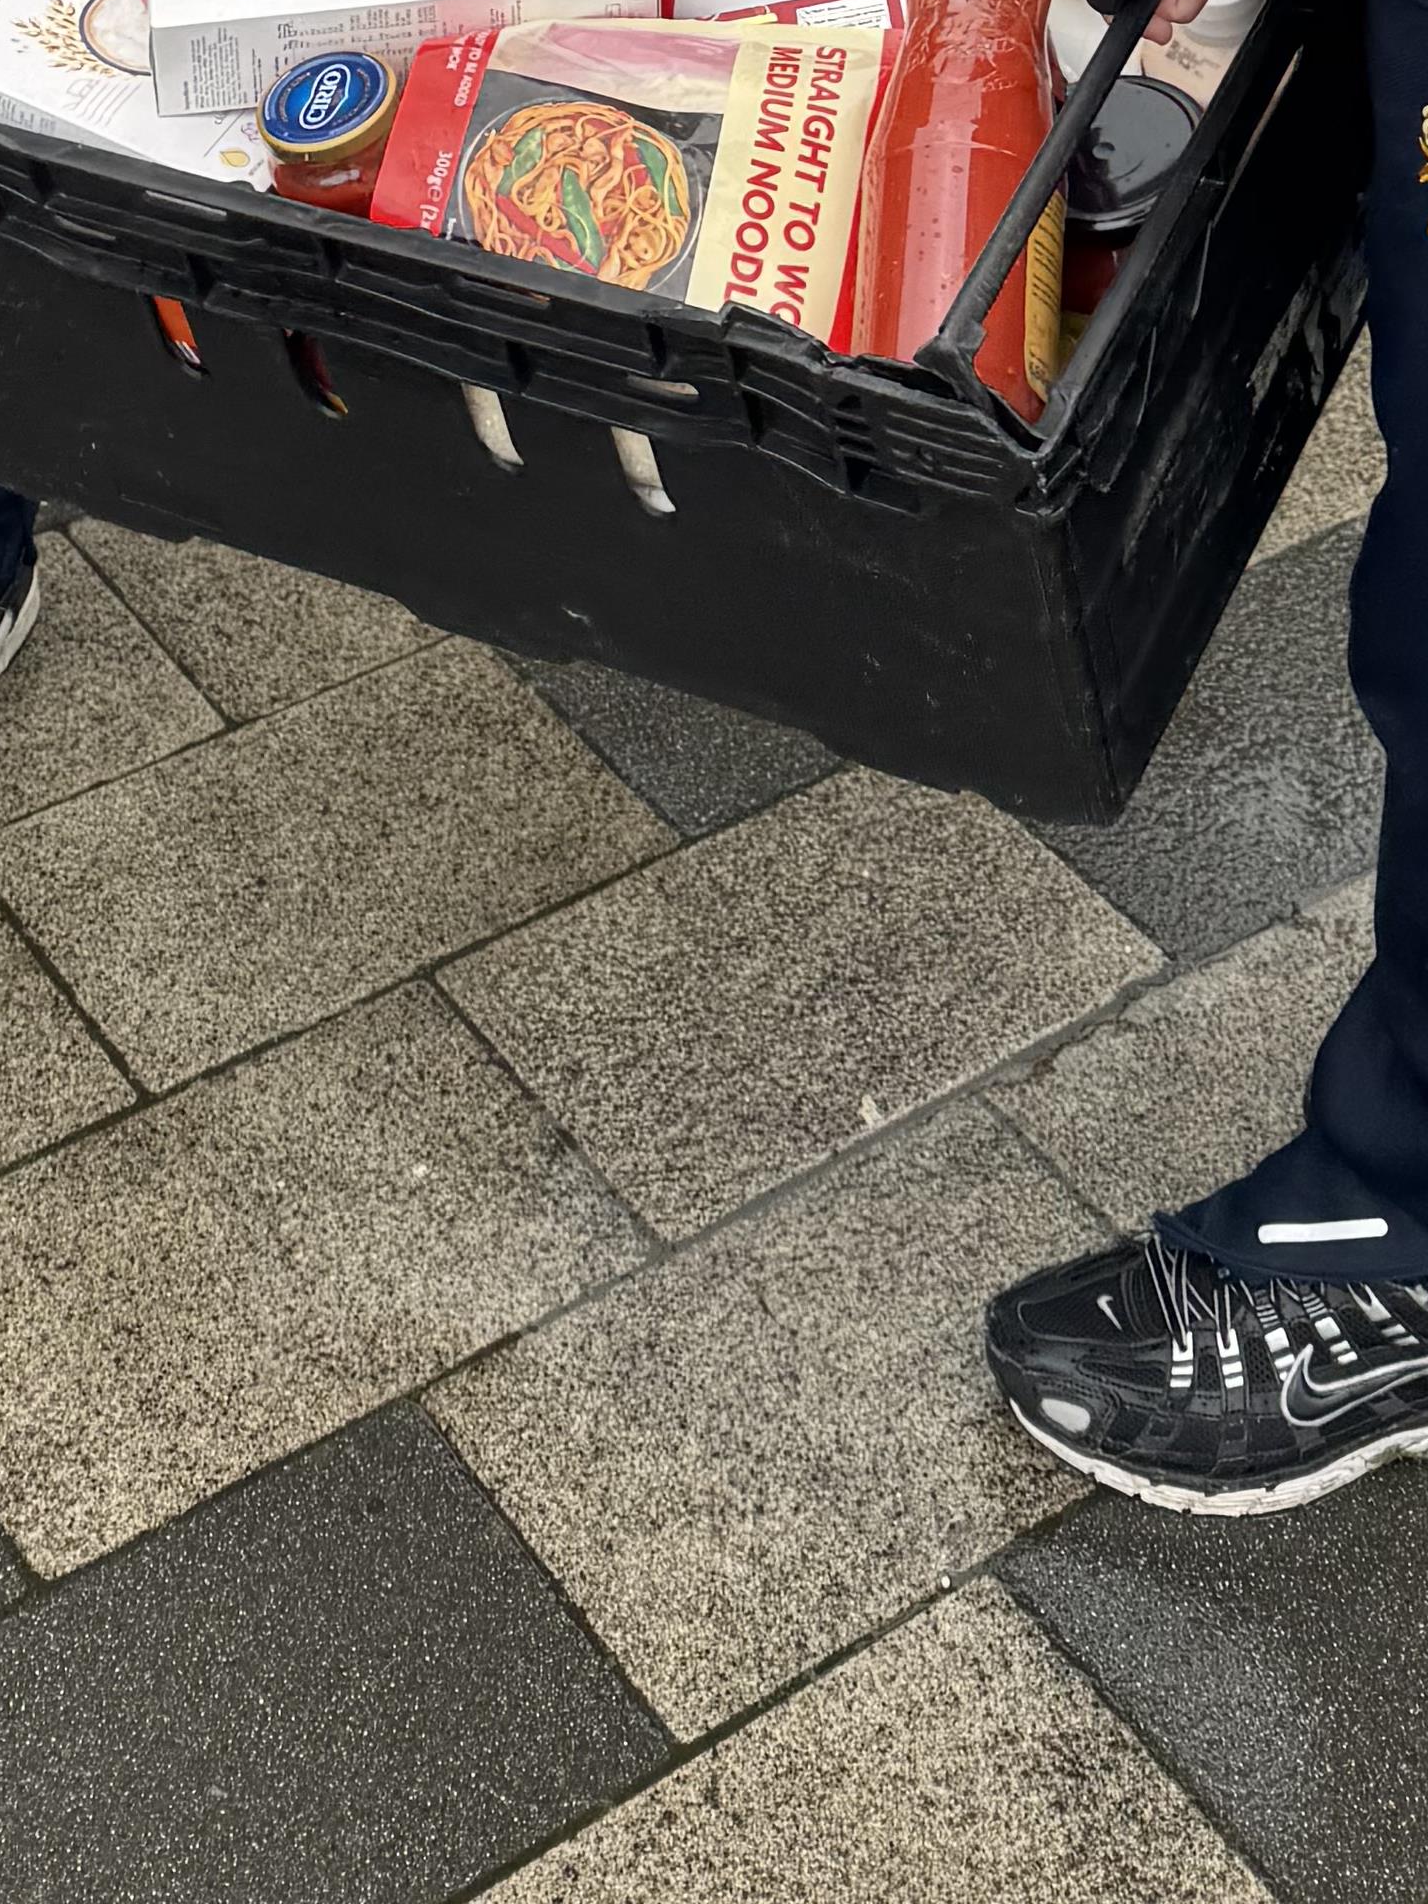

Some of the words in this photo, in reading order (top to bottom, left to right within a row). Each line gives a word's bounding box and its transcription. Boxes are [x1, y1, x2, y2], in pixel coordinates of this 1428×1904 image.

[306, 71, 341, 122] CIRIO
[754, 46, 803, 152] MEDIUM
[795, 46, 847, 193] STRAIGHT
[724, 158, 782, 302] NOODL
[783, 201, 820, 252] TO
